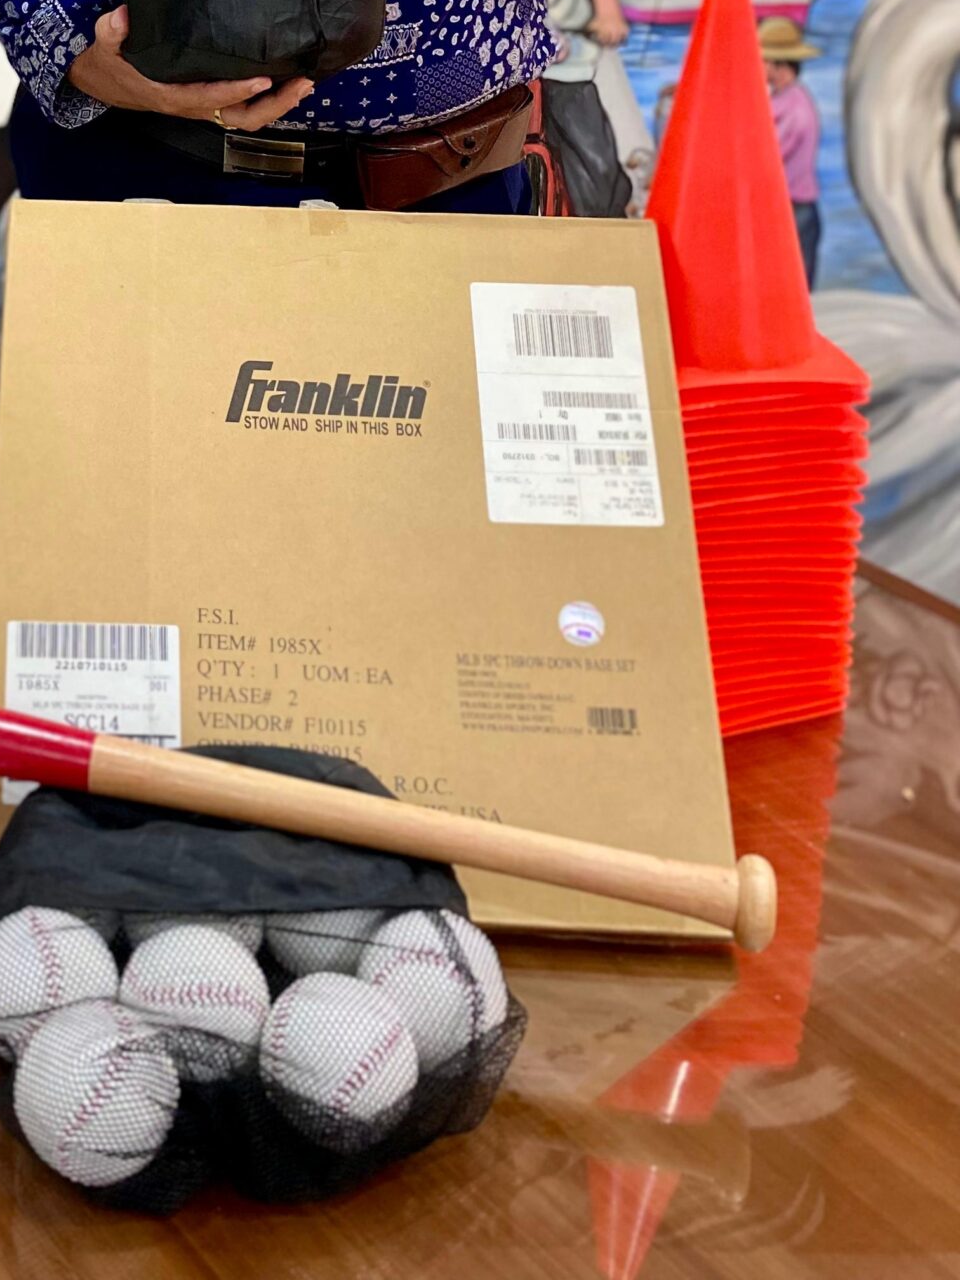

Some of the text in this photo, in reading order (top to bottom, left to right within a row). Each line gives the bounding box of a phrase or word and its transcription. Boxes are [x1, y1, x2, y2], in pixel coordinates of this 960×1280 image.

[225, 360, 428, 423] franklin
[244, 415, 422, 437] STOW AND SHIP IN THIS BOX
[197, 607, 239, 626] F.S.I.
[197, 633, 322, 656] ITEM# 1985X
[303, 664, 349, 683] UOM
[366, 668, 393, 686] EA
[197, 685, 298, 706] PHASE# 2
[64, 713, 120, 732] SCC14
[197, 711, 366, 737] VENDOR# F10115
[394, 775, 454, 796] R.O.C.
